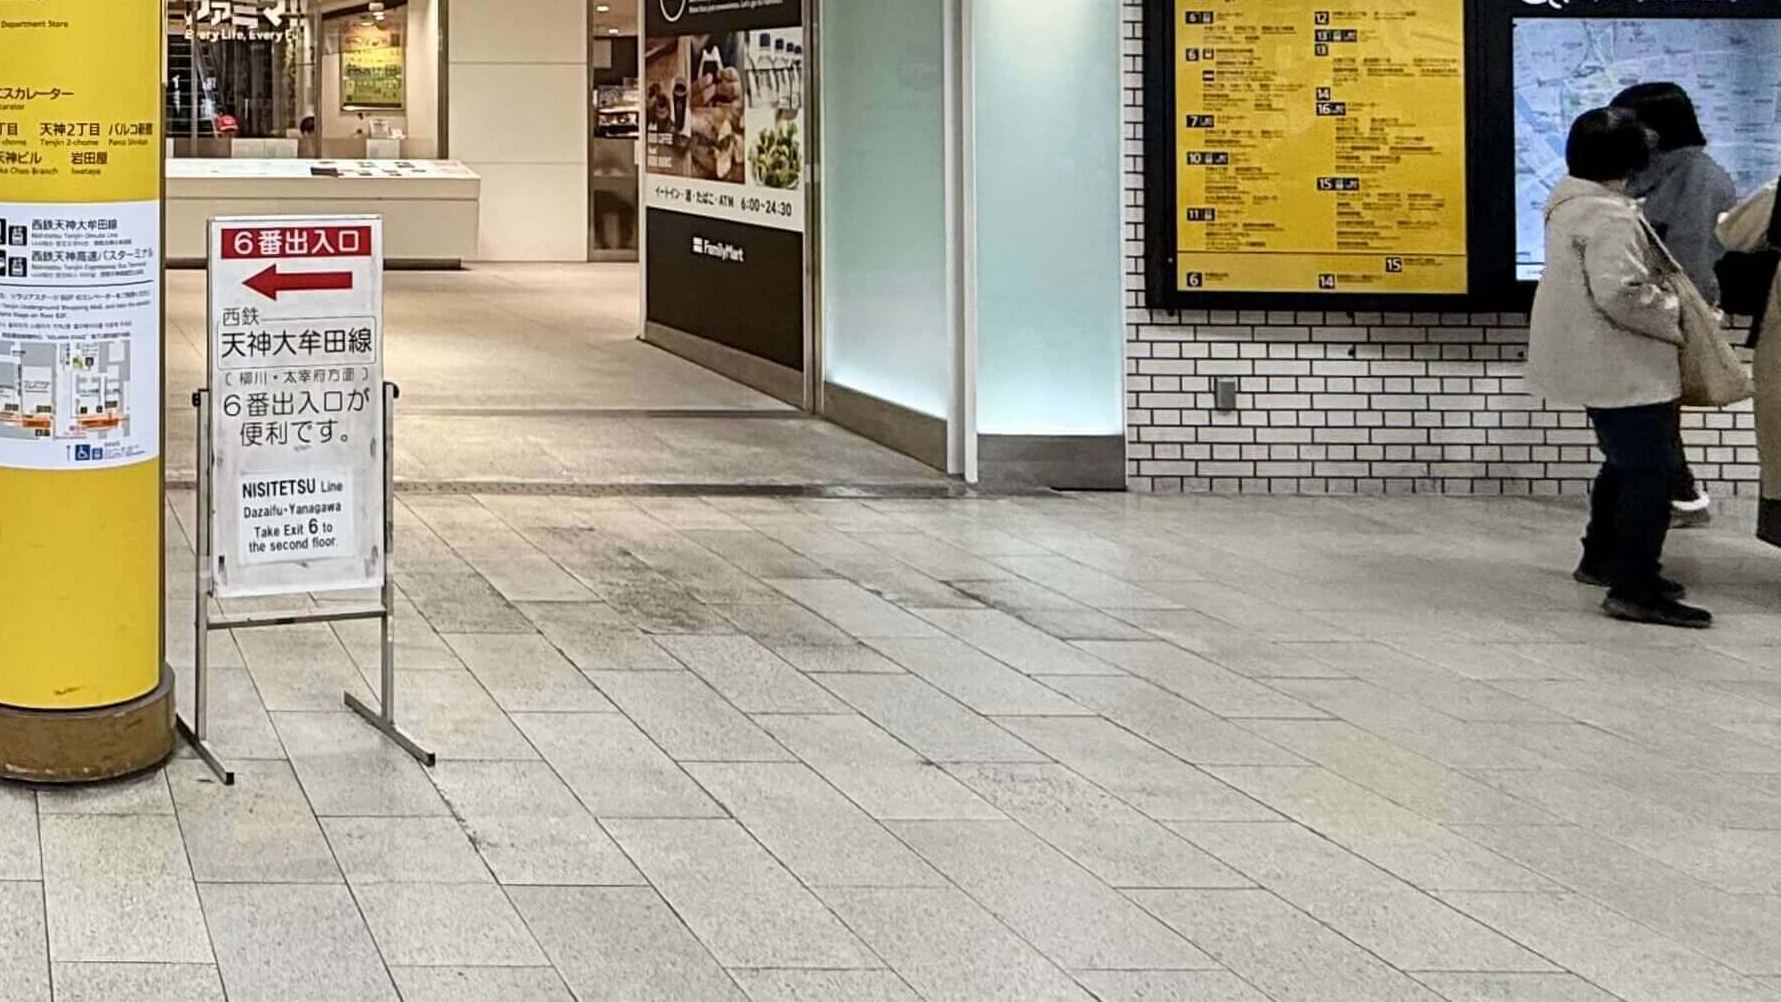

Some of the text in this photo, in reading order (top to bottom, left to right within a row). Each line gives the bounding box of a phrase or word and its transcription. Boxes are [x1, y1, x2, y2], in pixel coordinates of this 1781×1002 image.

[0, 20, 69, 29] Department Store
[1316, 12, 1328, 24] 12
[248, 30, 284, 44] Every
[1188, 50, 1198, 60] 6
[1317, 103, 1331, 115] 16
[1190, 116, 1199, 127] 7
[40, 122, 101, 137] 天神2丁目
[71, 151, 108, 165] 岩田屋
[1188, 153, 1203, 164] 10
[1318, 179, 1333, 190] 15
[1189, 210, 1201, 220] 11
[31, 218, 118, 231] 西鉄天神大牟田線
[233, 229, 360, 255] 6番出入口
[704, 239, 745, 263] FamilyMart
[1387, 259, 1402, 272] 15
[1188, 275, 1200, 287] 6
[1319, 275, 1335, 288] 14
[222, 306, 261, 327] 西鉄
[221, 327, 372, 359] 天神大牟田線
[223, 387, 370, 417] 6番出入口が
[239, 418, 349, 447] 便利です。
[242, 477, 344, 499] NISITETSU Line
[254, 518, 333, 538] Take Exit 6 to
[249, 540, 266, 553] the
[269, 538, 309, 552] second
